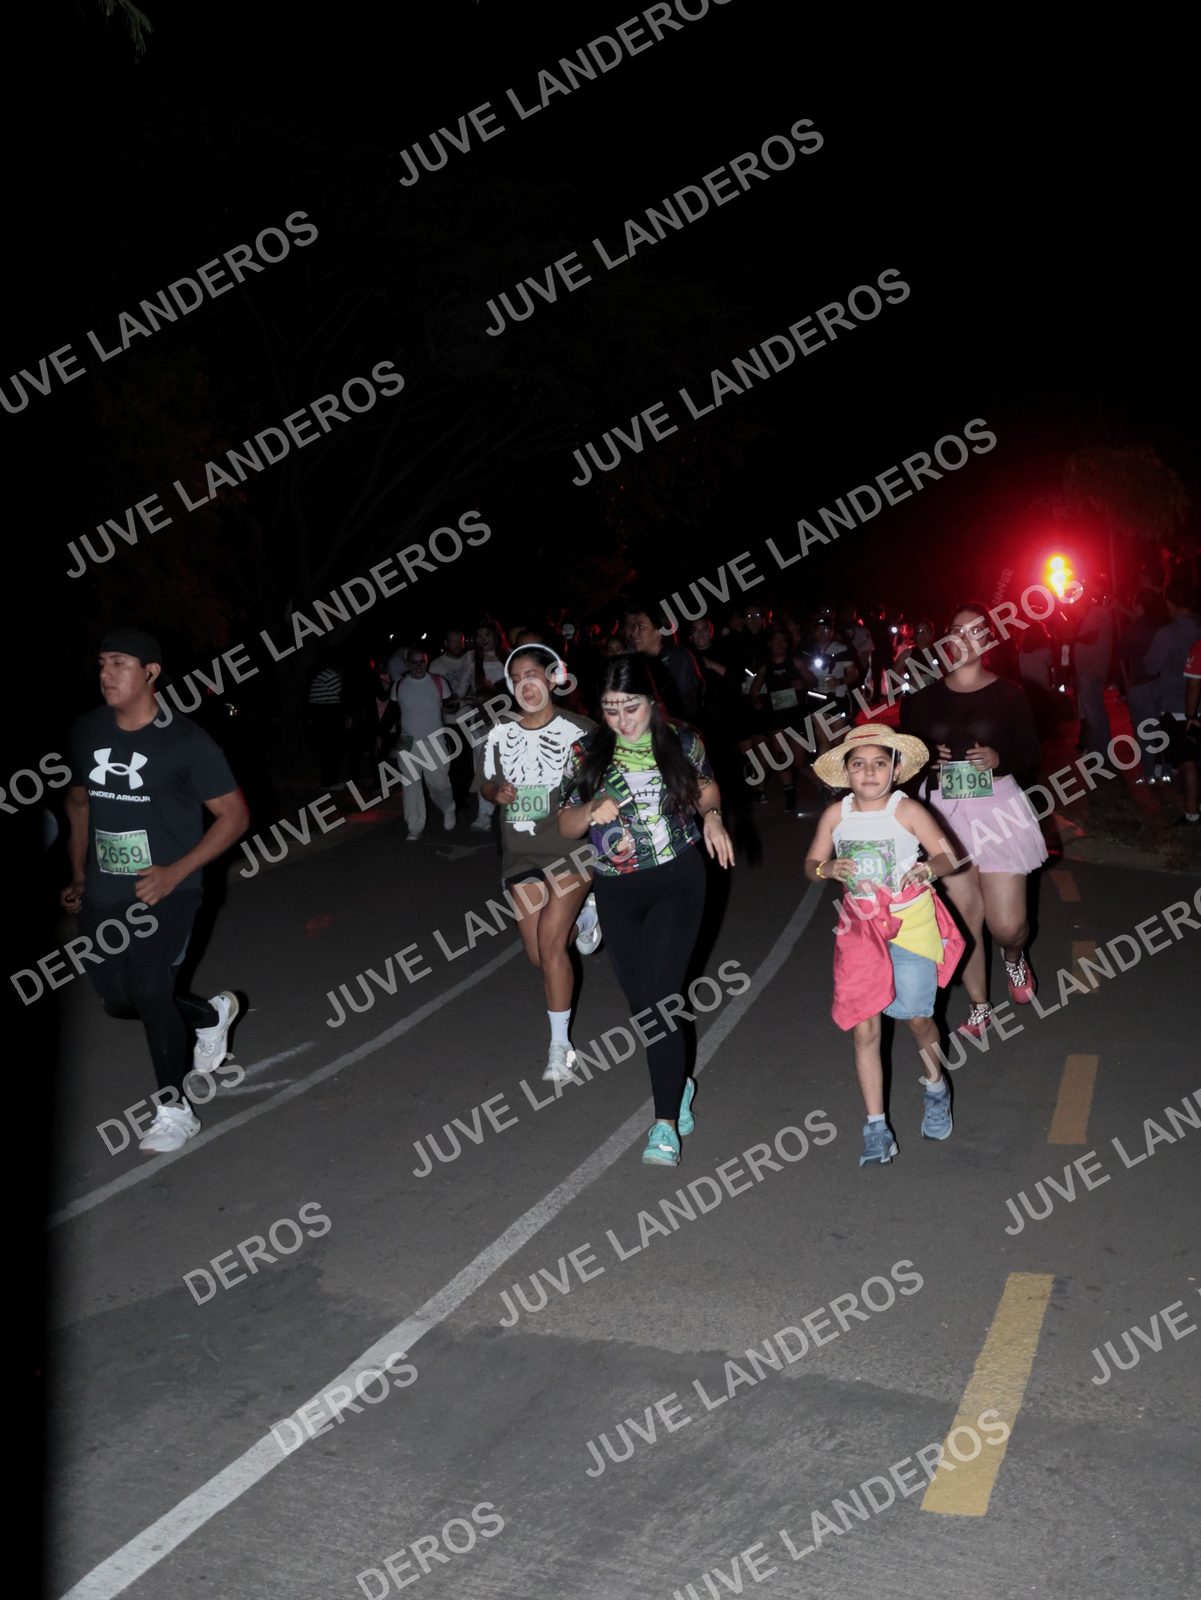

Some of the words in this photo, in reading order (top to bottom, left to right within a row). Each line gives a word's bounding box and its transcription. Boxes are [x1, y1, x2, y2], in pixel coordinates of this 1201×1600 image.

[945, 771, 988, 791] 3196
[88, 790, 115, 800] UNDER
[116, 794, 151, 802] ARMOUR
[505, 795, 544, 813] 660
[100, 845, 144, 865] 2659
[854, 857, 884, 876] 81
